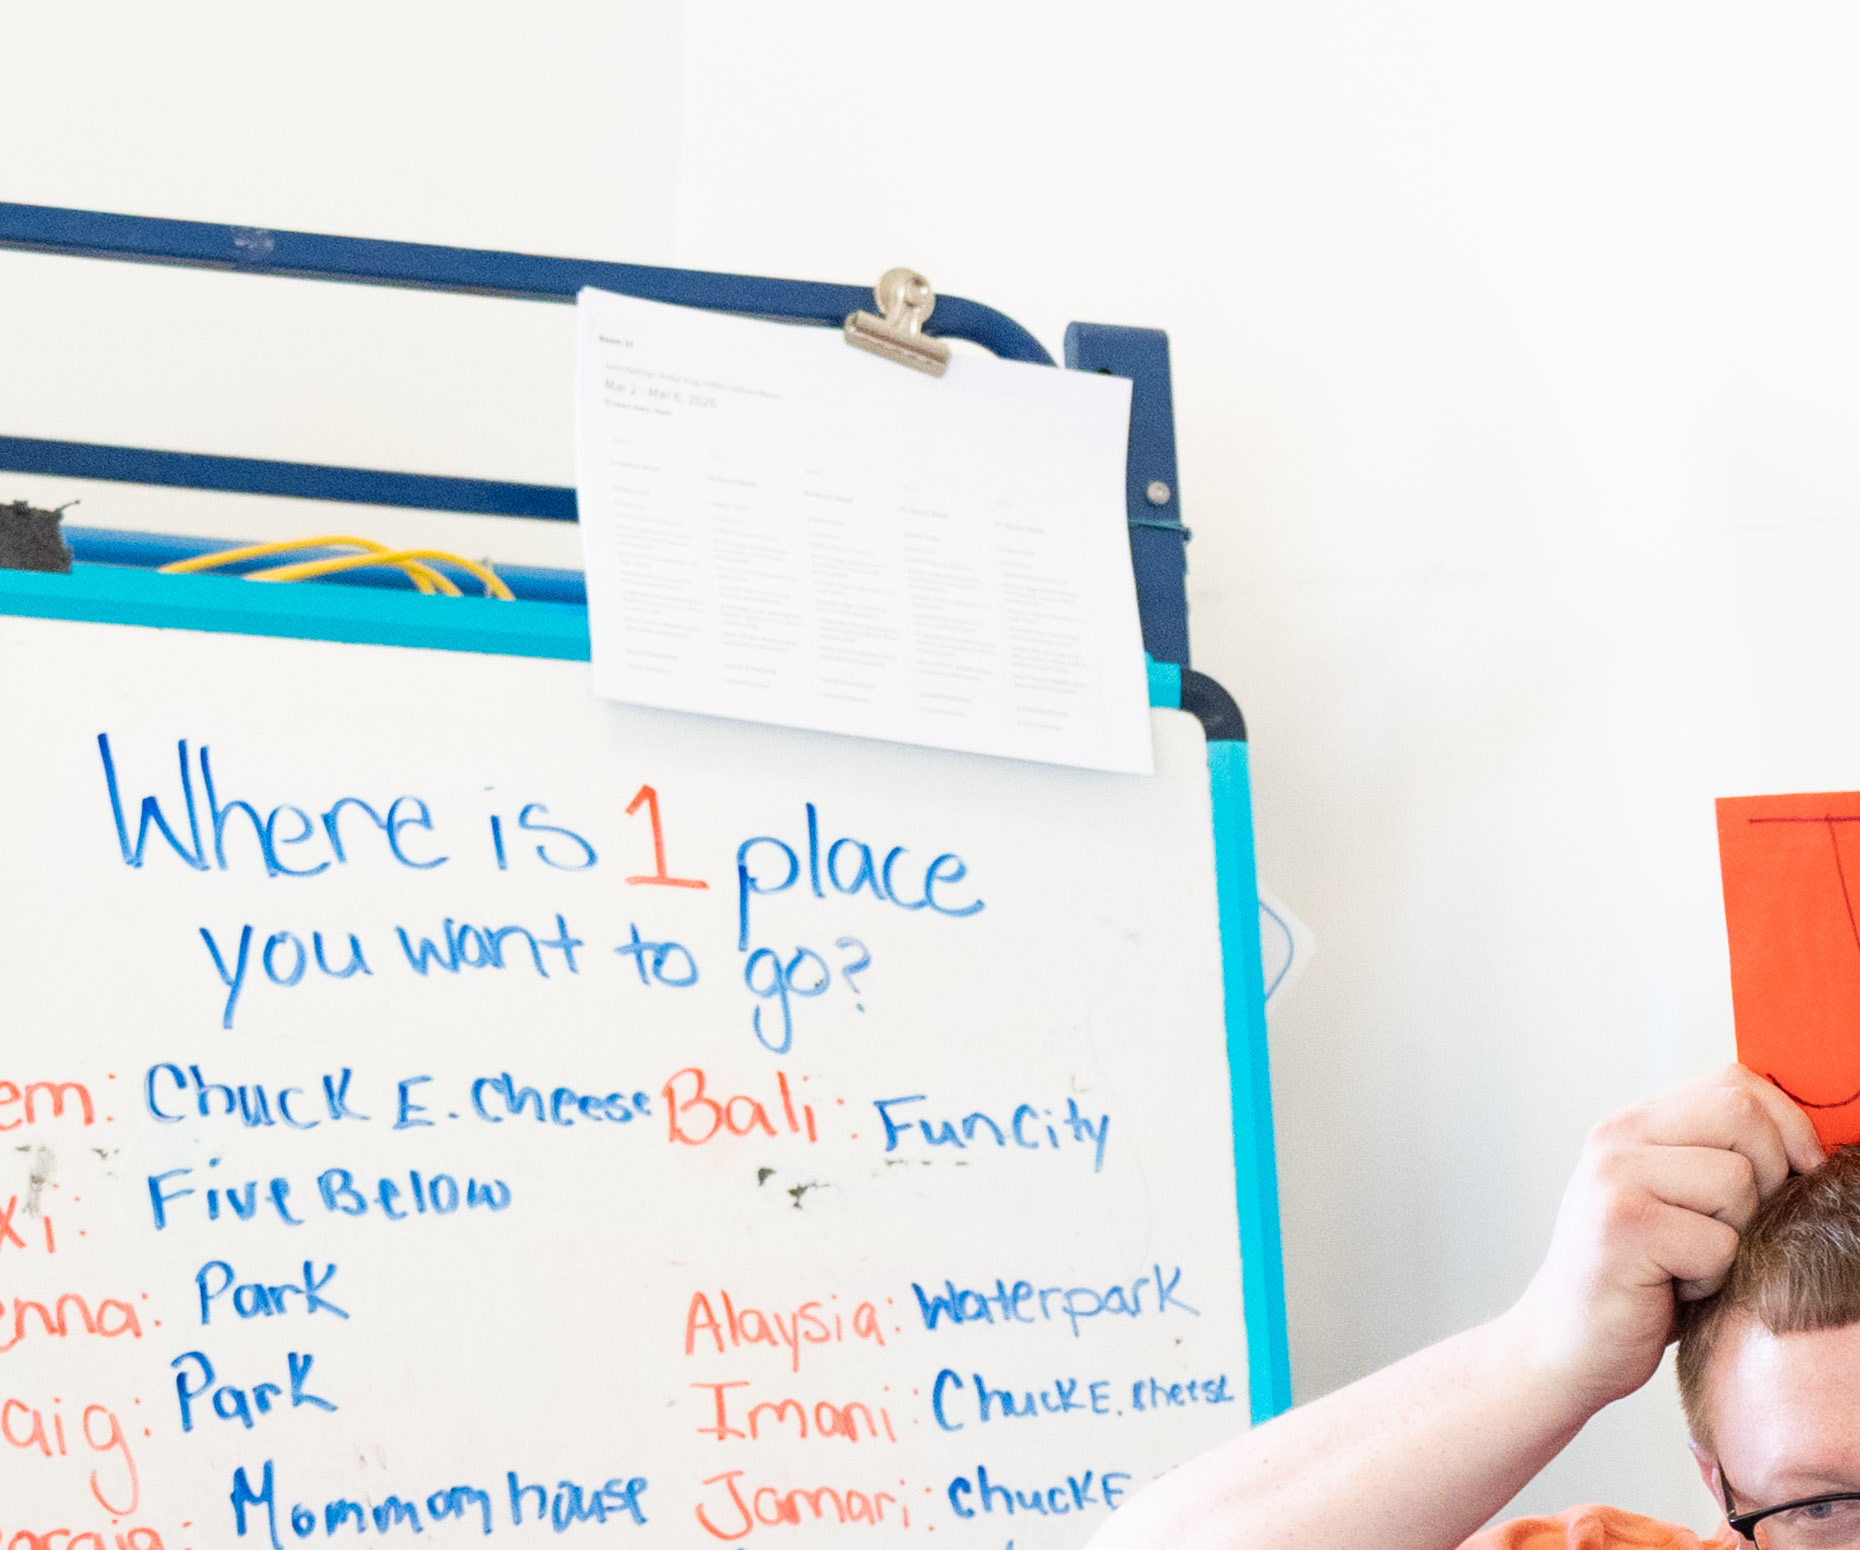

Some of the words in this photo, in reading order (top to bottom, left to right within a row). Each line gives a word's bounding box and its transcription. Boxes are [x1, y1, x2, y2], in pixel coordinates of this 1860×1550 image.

[98, 733, 449, 877] Where
[484, 785, 598, 873] is
[625, 784, 709, 890] 1
[736, 801, 986, 952] place
[199, 923, 373, 1029] you
[395, 914, 584, 978] want
[613, 922, 699, 986] to
[743, 936, 871, 1055] go?
[393, 1075, 459, 1129] E.
[662, 1067, 858, 1145] Bali:
[147, 1157, 304, 1230] Five
[317, 1167, 511, 1221] Below
[0, 1292, 162, 1353] nna:
[685, 1289, 901, 1372] Alaysia:
[689, 1380, 920, 1444] Imani:
[695, 1470, 935, 1541] Jamari:
